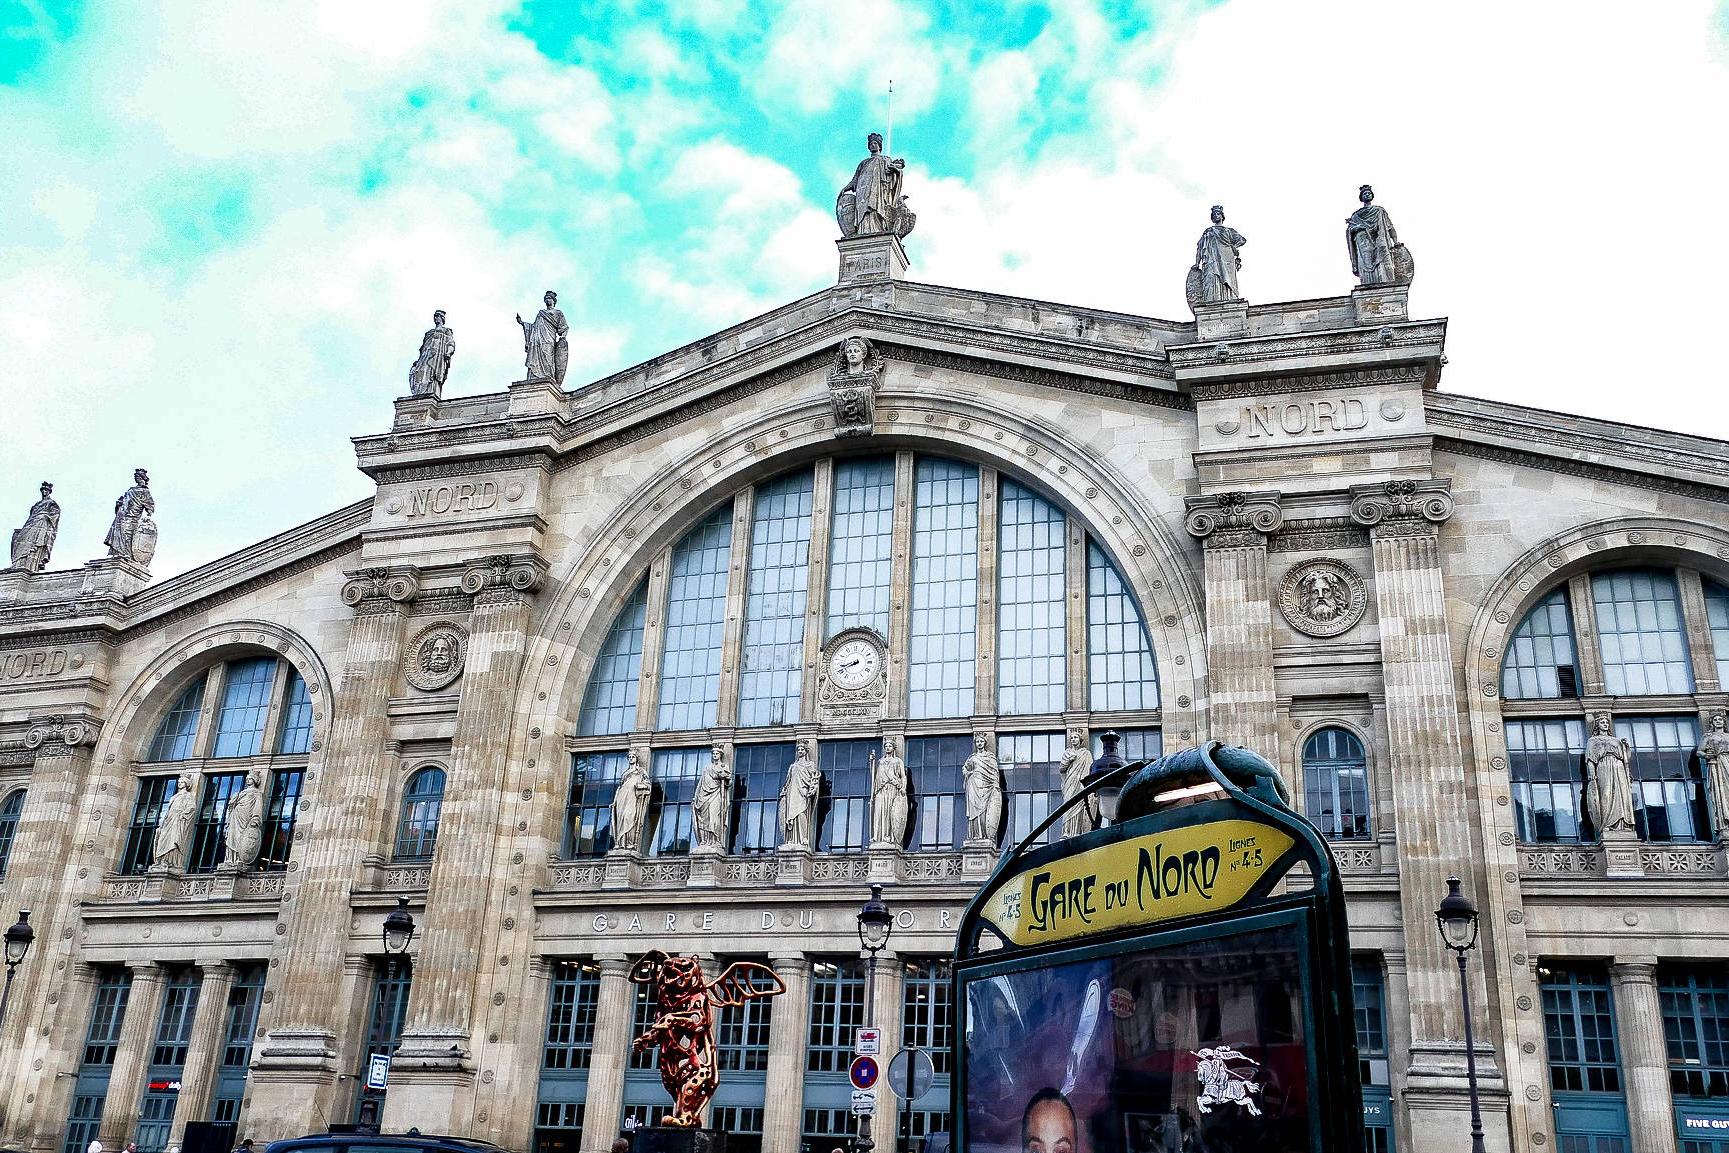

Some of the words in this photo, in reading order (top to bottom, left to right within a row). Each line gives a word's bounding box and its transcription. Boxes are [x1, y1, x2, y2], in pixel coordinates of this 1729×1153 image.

[1246, 399, 1369, 438] NORD
[406, 481, 499, 517] NORD
[1229, 836, 1256, 853] LIGNES
[1028, 871, 1097, 934] GARE
[1105, 879, 1128, 910] DU
[1137, 843, 1220, 911] NORD
[592, 912, 714, 932] GARE
[761, 911, 813, 930] DU
[896, 909, 951, 928] OR
[1686, 1119, 1710, 1128] FIVE
